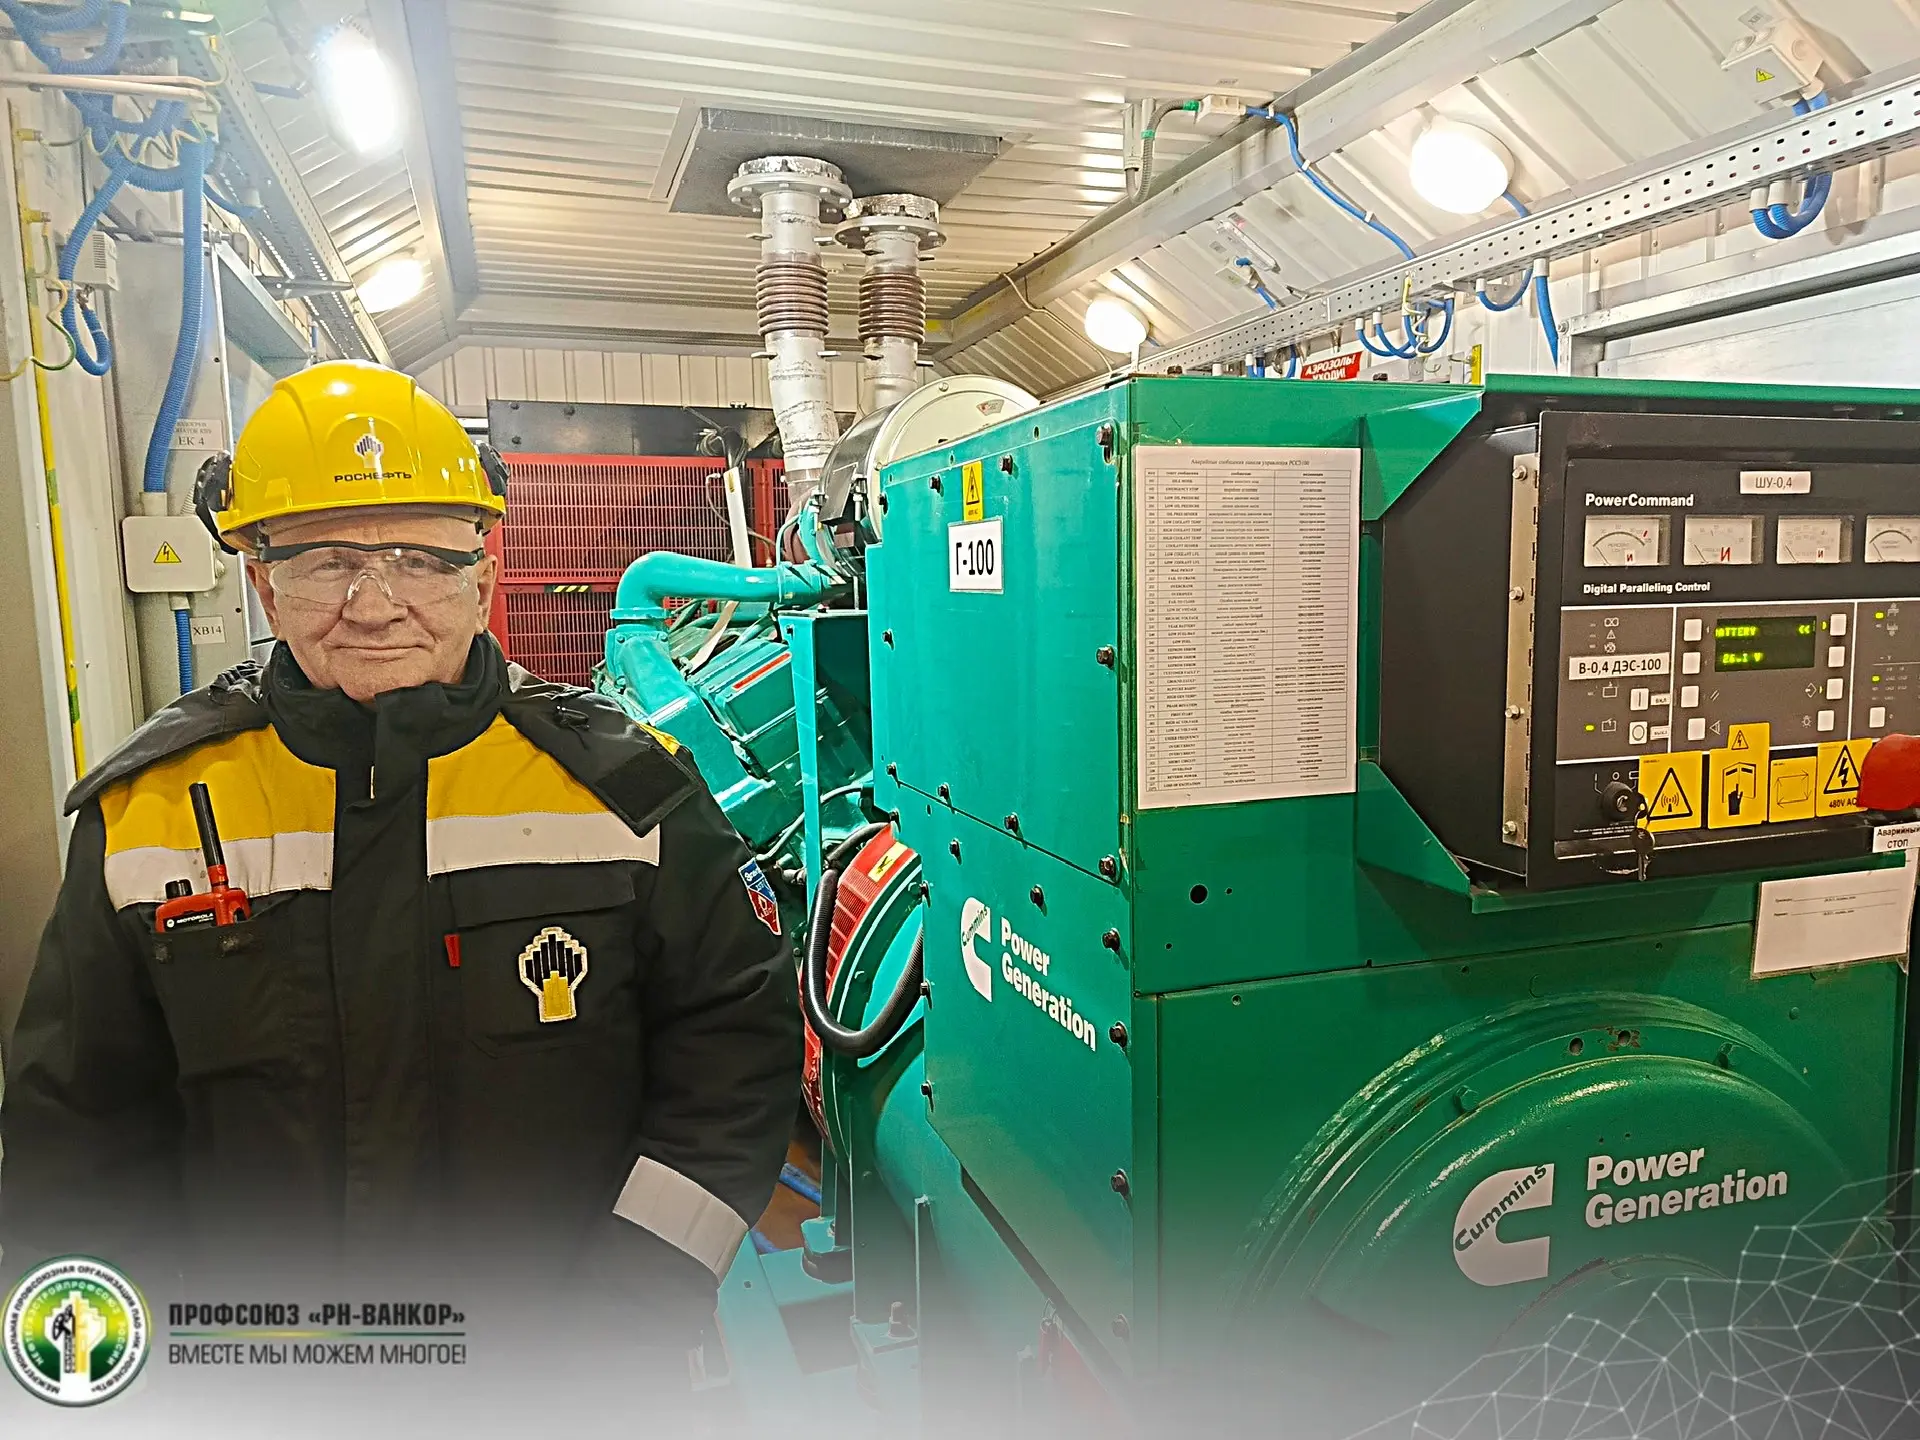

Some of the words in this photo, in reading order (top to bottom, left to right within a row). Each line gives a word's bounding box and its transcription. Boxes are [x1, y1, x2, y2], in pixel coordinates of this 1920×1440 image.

[1305, 354, 1356, 375] АЭРОЗОЛЬ!
[198, 437, 205, 445] 4
[334, 471, 412, 482] РОСНЕФТЬ
[1755, 477, 1792, 490] ШУ-0,4
[1585, 493, 1694, 507] PowerCommand
[955, 538, 994, 576] Г-100
[1720, 546, 1731, 562] И
[1583, 584, 1617, 596] Digital
[1619, 583, 1673, 594] Paralleling
[1674, 581, 1710, 592] Control
[1579, 661, 1609, 675] В-0,4
[1612, 658, 1661, 675] ДЭС-100
[1829, 798, 1845, 808] 480V
[1887, 839, 1909, 849] СТОП
[176, 912, 214, 924] MOTOROLA
[1001, 916, 1050, 977] Power
[1001, 951, 1096, 1052] Generation
[1586, 1147, 1705, 1191] Power
[1585, 1168, 1788, 1229] Generation
[1453, 1164, 1547, 1252] Cummins
